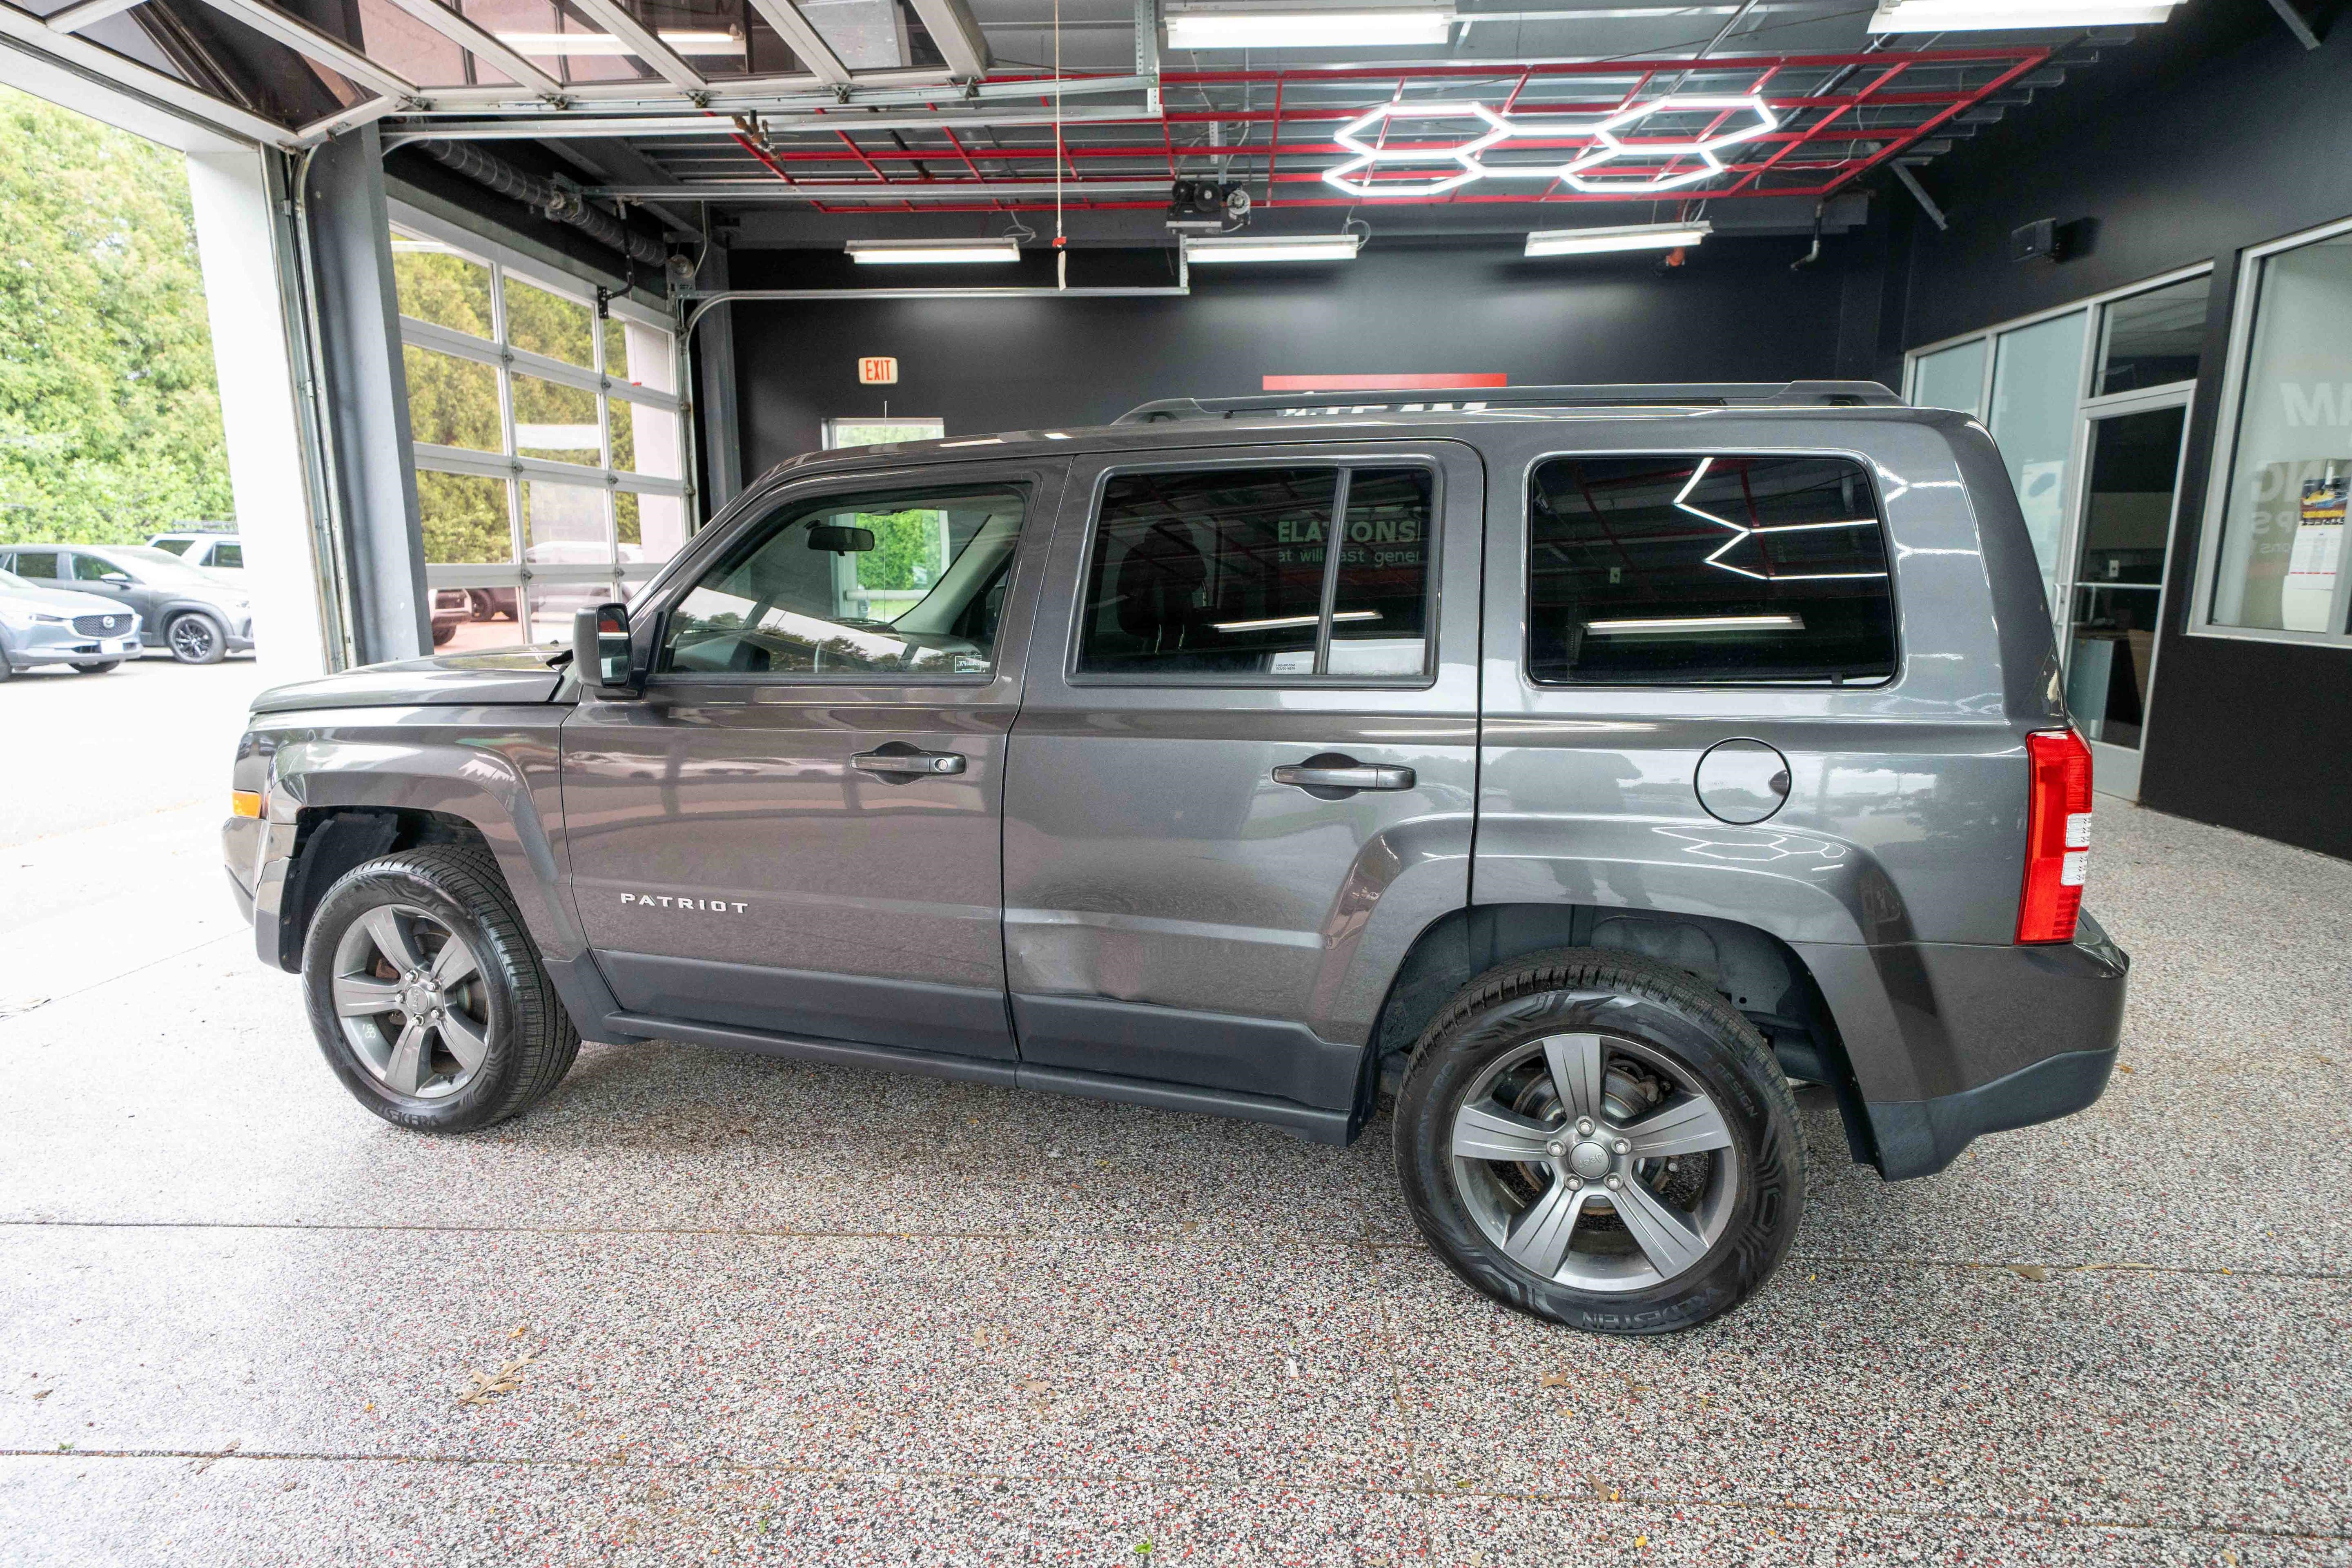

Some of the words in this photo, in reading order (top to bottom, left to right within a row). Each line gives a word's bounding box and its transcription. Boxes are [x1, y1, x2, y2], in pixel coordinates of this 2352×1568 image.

[865, 360, 891, 381] EXIT
[1278, 521, 1421, 543] ELAIONS
[1278, 549, 1293, 562] at
[1300, 547, 1323, 562] will
[1340, 549, 1364, 562] ast
[620, 893, 748, 913] PATRIOT
[1716, 1062, 1758, 1118] DESIGN
[1577, 1152, 1603, 1169] Jeep
